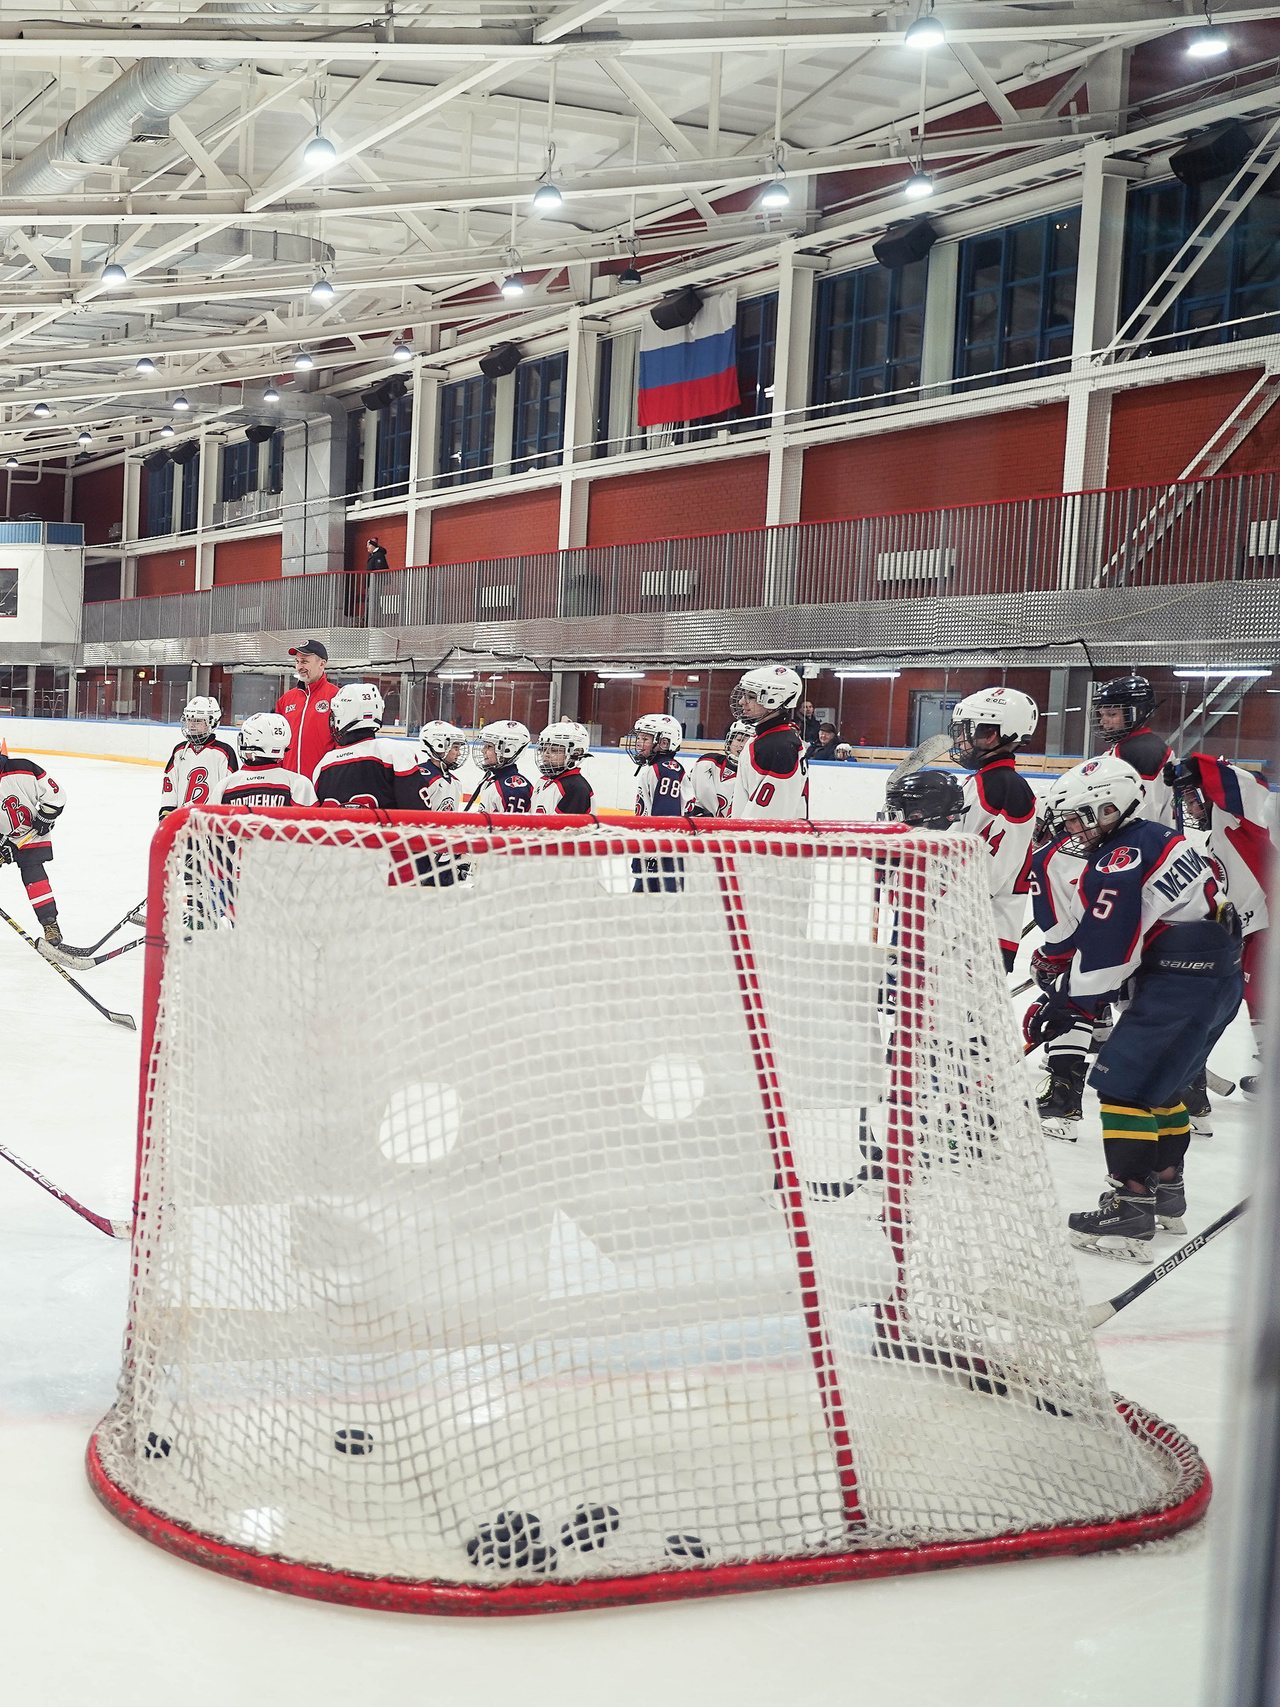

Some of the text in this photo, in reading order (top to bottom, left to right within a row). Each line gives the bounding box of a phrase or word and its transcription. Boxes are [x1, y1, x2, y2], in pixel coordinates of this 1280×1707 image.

[361, 693, 372, 701] 33
[273, 727, 284, 736] 25
[659, 777, 682, 799] 88
[1092, 888, 1119, 920] 5
[1159, 959, 1215, 970] BAUER
[1153, 1236, 1207, 1281] BAUER
